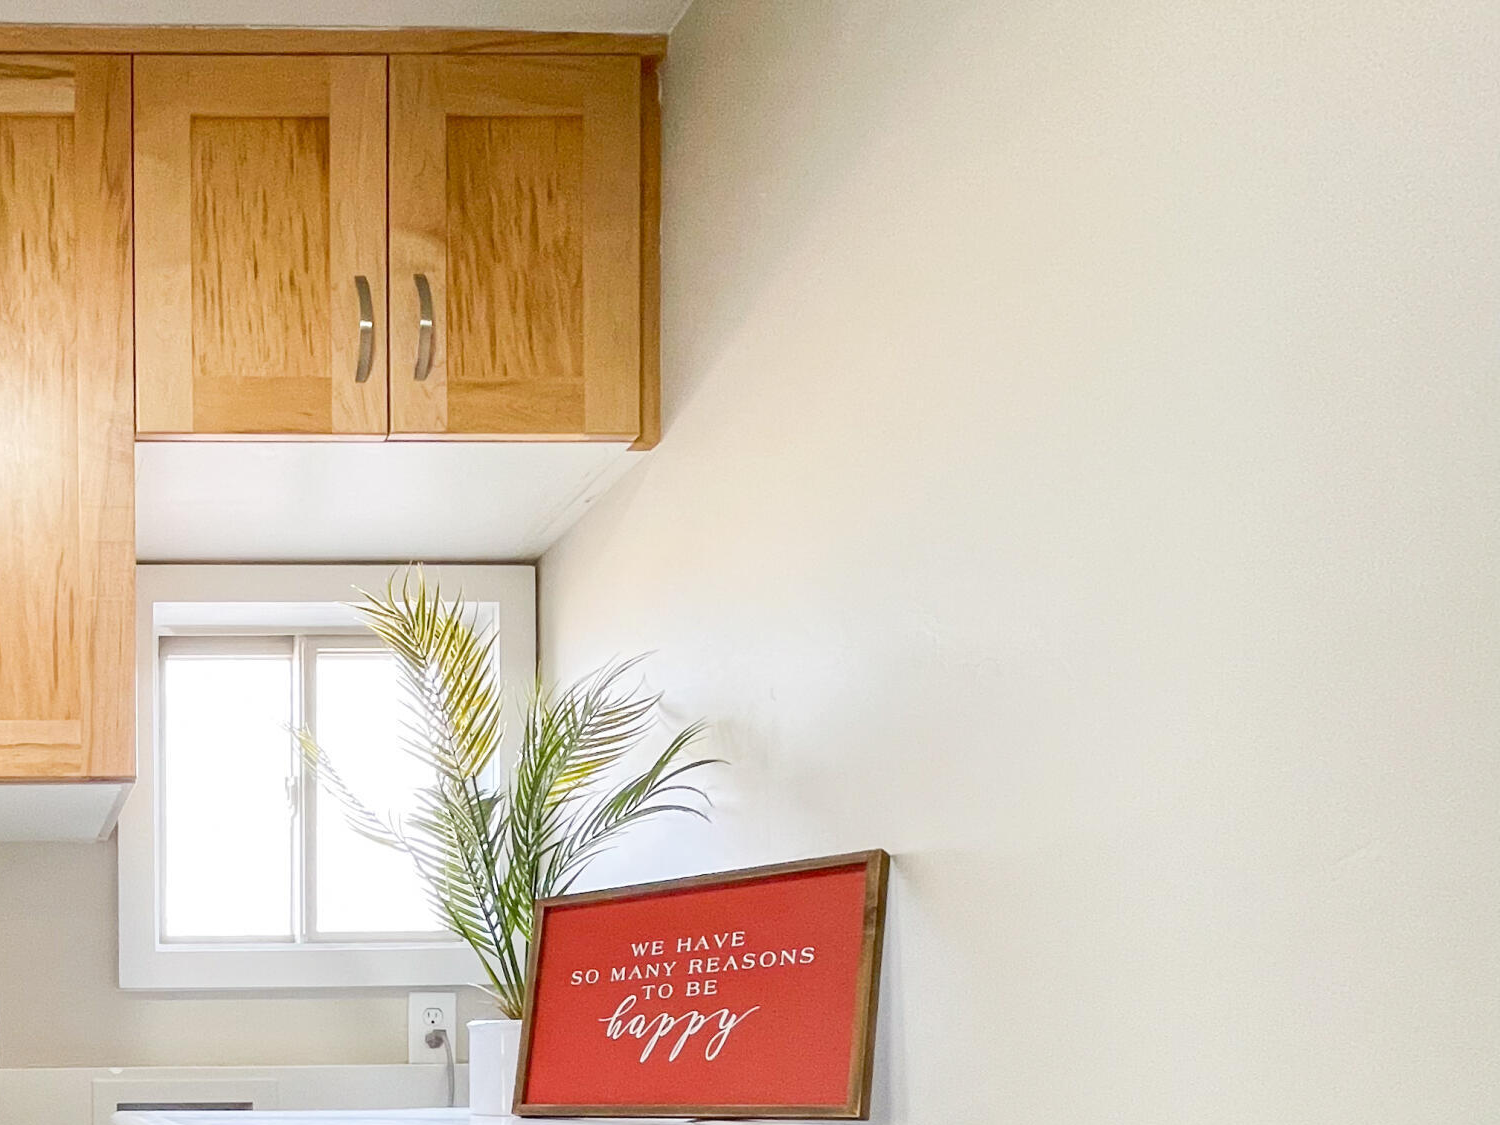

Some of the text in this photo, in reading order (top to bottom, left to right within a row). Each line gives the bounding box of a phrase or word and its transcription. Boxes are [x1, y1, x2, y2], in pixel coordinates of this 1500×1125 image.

[631, 931, 746, 958] WE HAVE
[570, 947, 816, 986] SO MANY REASONS
[642, 980, 718, 1000] TO BE
[599, 994, 760, 1063] happy
